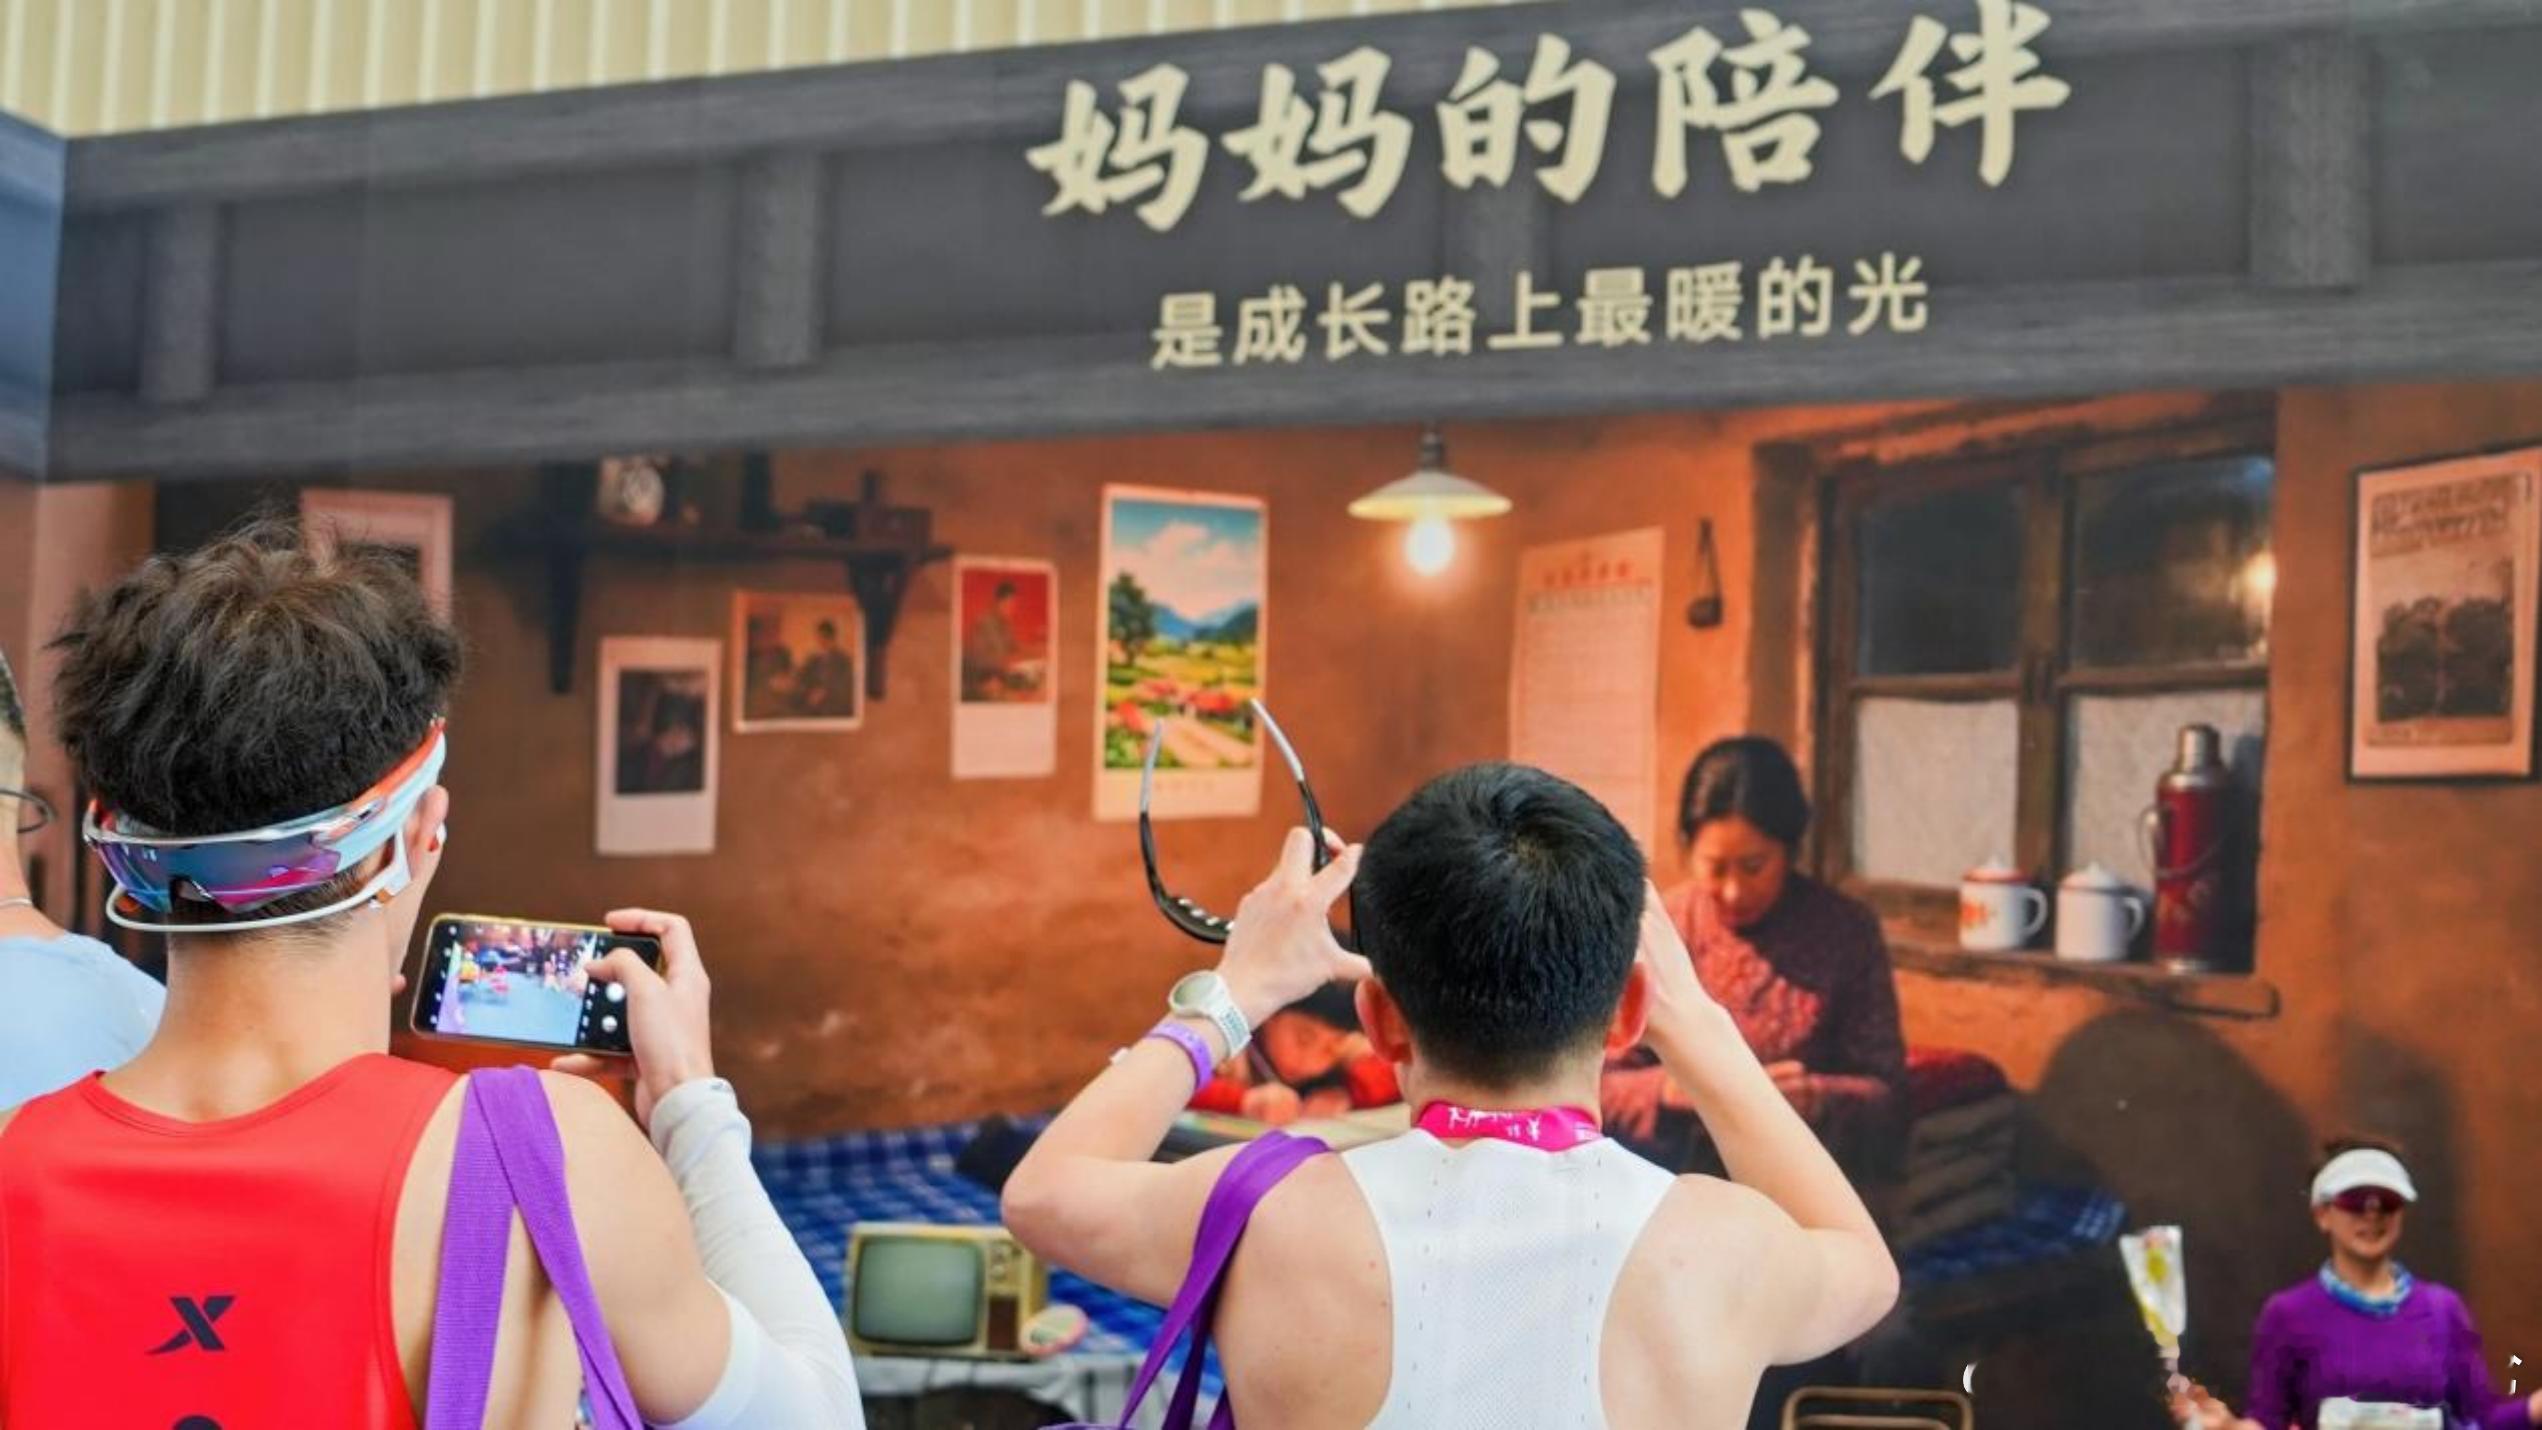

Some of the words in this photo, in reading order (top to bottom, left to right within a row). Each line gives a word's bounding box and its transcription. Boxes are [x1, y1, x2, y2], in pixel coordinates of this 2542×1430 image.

[1026, 0, 2071, 231] 妈妈的陪伴
[1151, 253, 1930, 369] 是成长路上最暖的光
